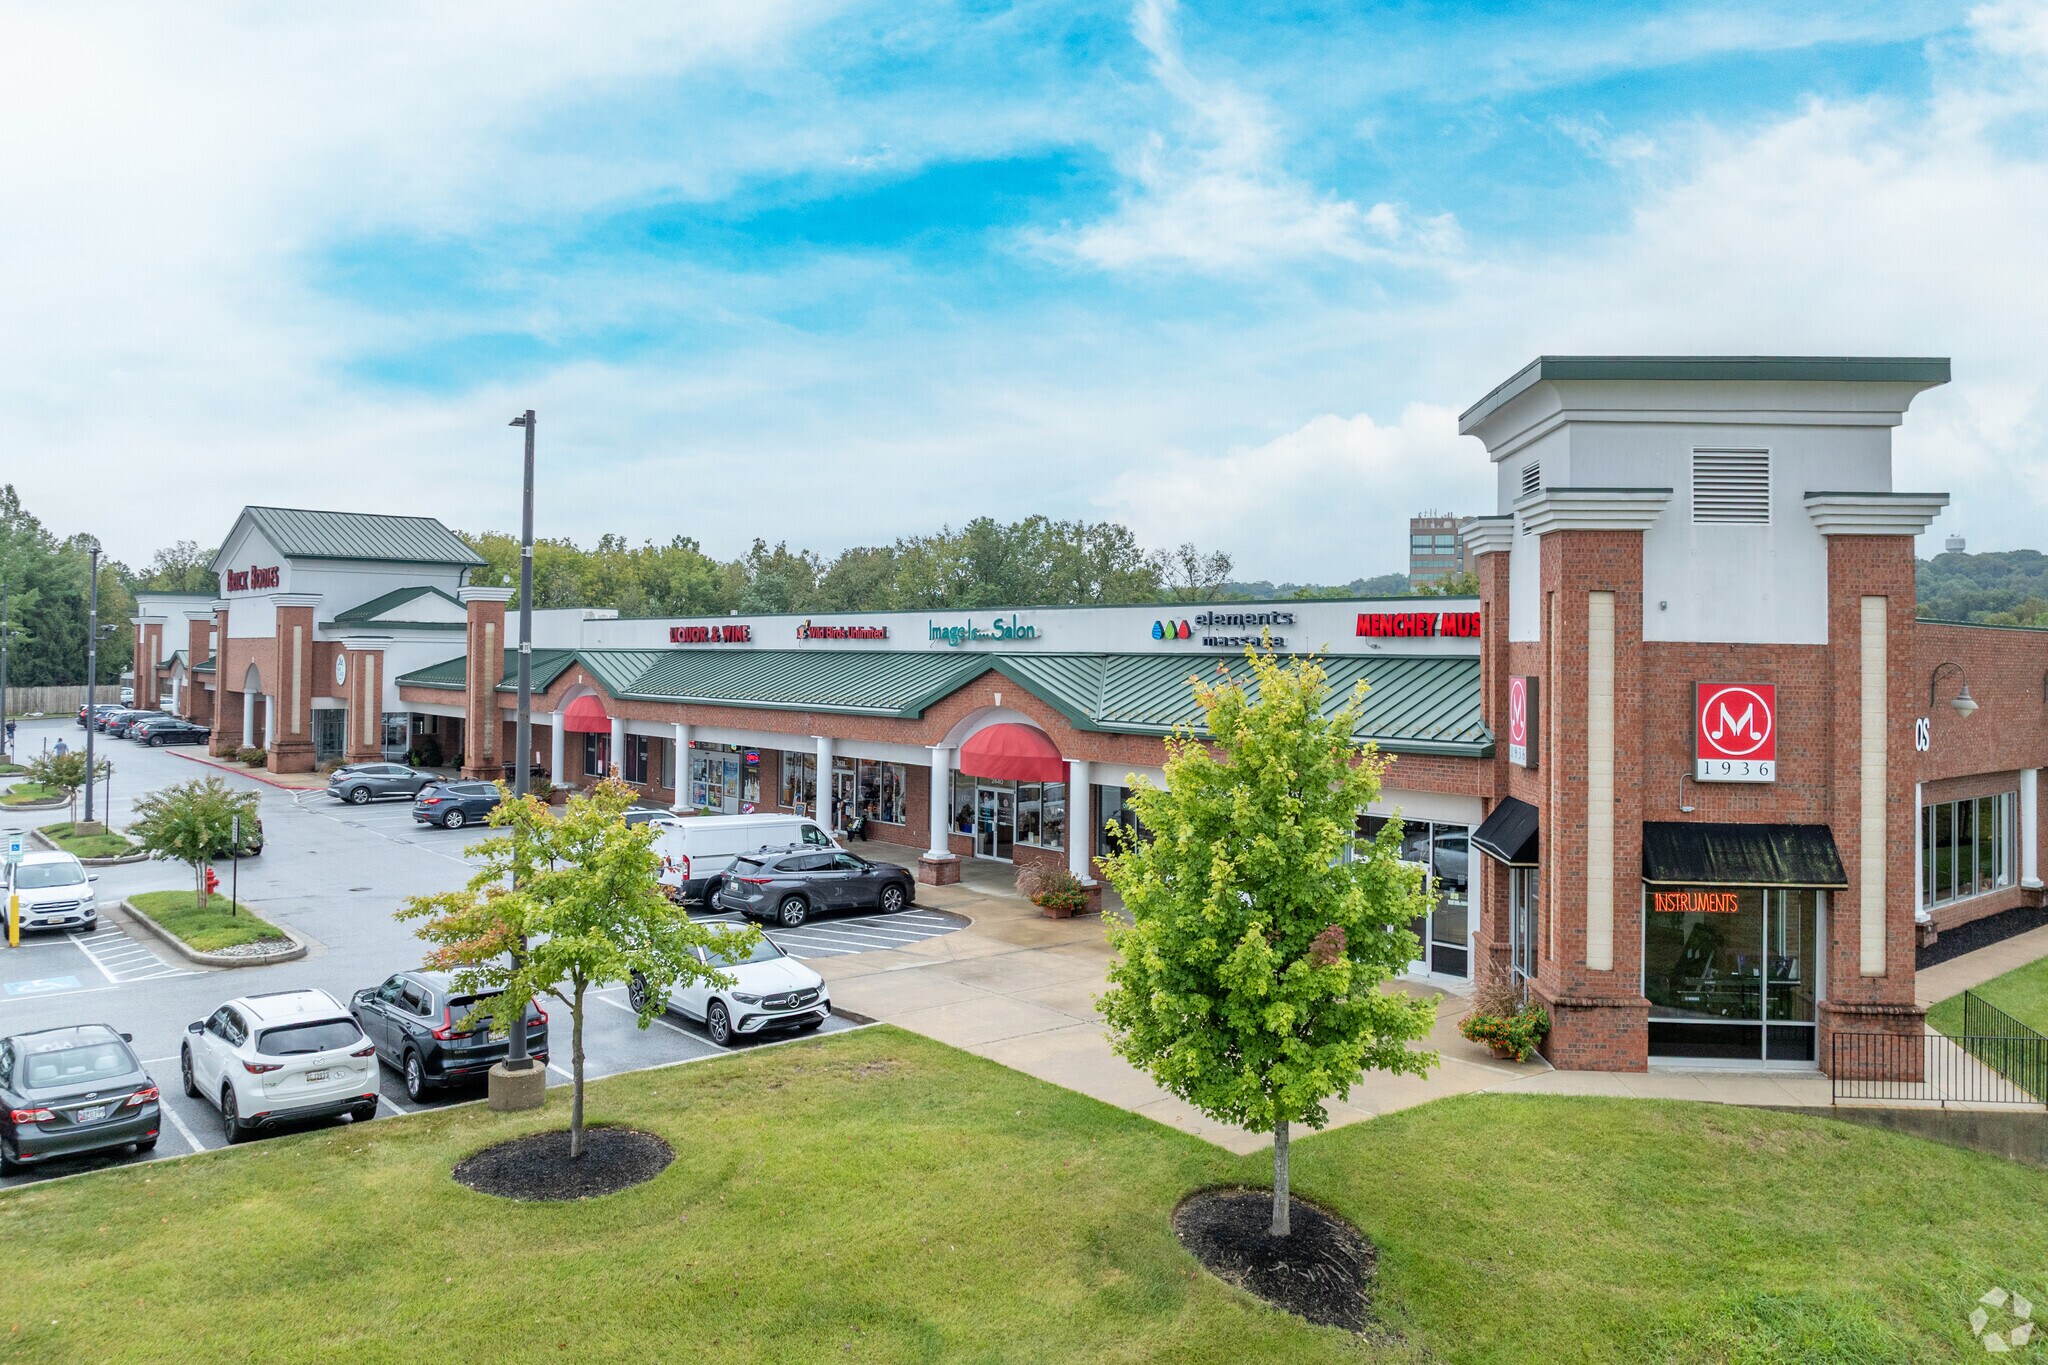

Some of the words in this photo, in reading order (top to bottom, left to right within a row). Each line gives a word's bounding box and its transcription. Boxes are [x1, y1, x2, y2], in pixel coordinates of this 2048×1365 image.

[227, 569, 249, 592] BRICK
[251, 565, 280, 589] BODIES
[1195, 611, 1294, 626] elements
[1356, 613, 1439, 637] MENCHEY
[1440, 612, 1480, 638] MUS
[670, 626, 709, 643] LIQUOR
[711, 626, 721, 643] &
[722, 625, 751, 643] WINE
[808, 626, 825, 639] Wild
[825, 626, 846, 639] Birds
[847, 626, 888, 639] Unlimited
[929, 619, 966, 647] Image
[991, 613, 1035, 641] Salon
[1711, 702, 1762, 741] M
[1704, 761, 1769, 776] 1936
[1654, 892, 1738, 913] INSTRUMENTS
